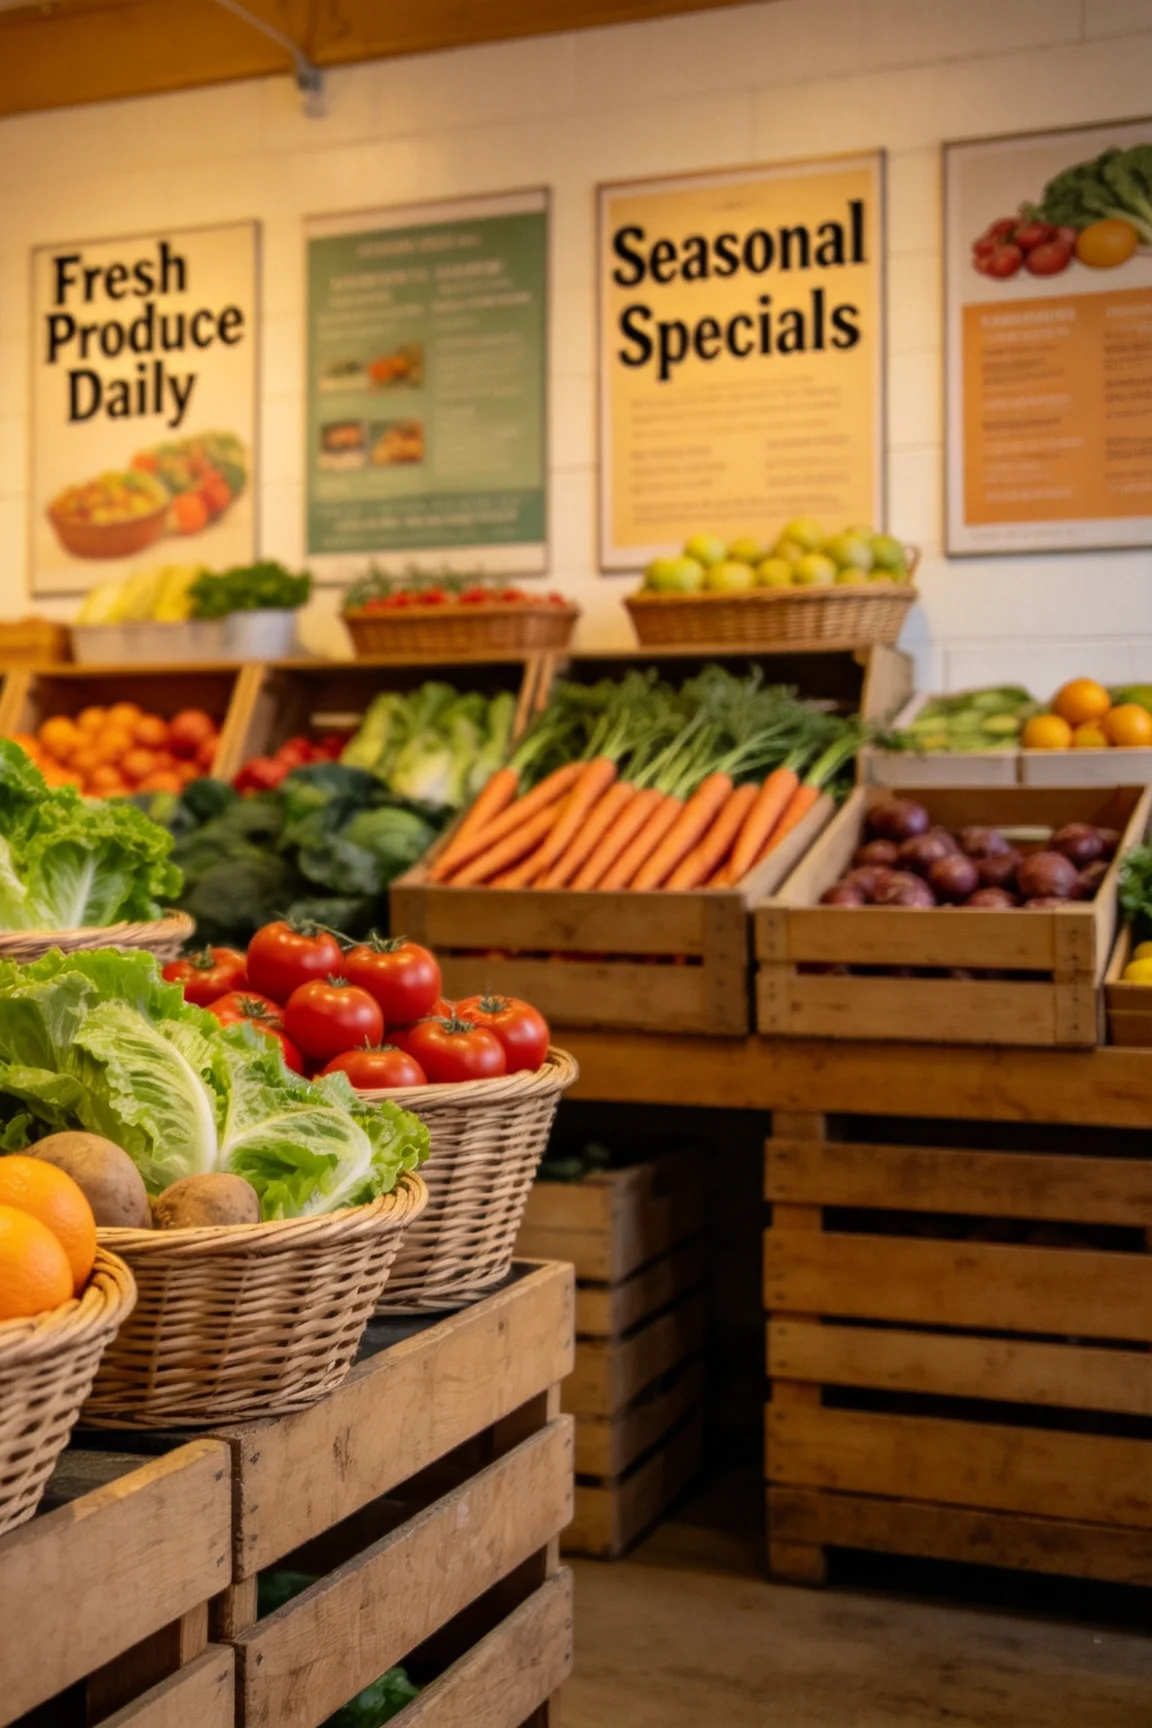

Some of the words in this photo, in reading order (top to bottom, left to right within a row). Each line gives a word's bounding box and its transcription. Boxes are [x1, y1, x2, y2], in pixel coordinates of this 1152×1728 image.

[52, 241, 186, 306] Fresh
[612, 199, 868, 287] Seasonal
[46, 303, 244, 364] Produce
[619, 288, 861, 381] Specials
[67, 361, 197, 428] Daily
